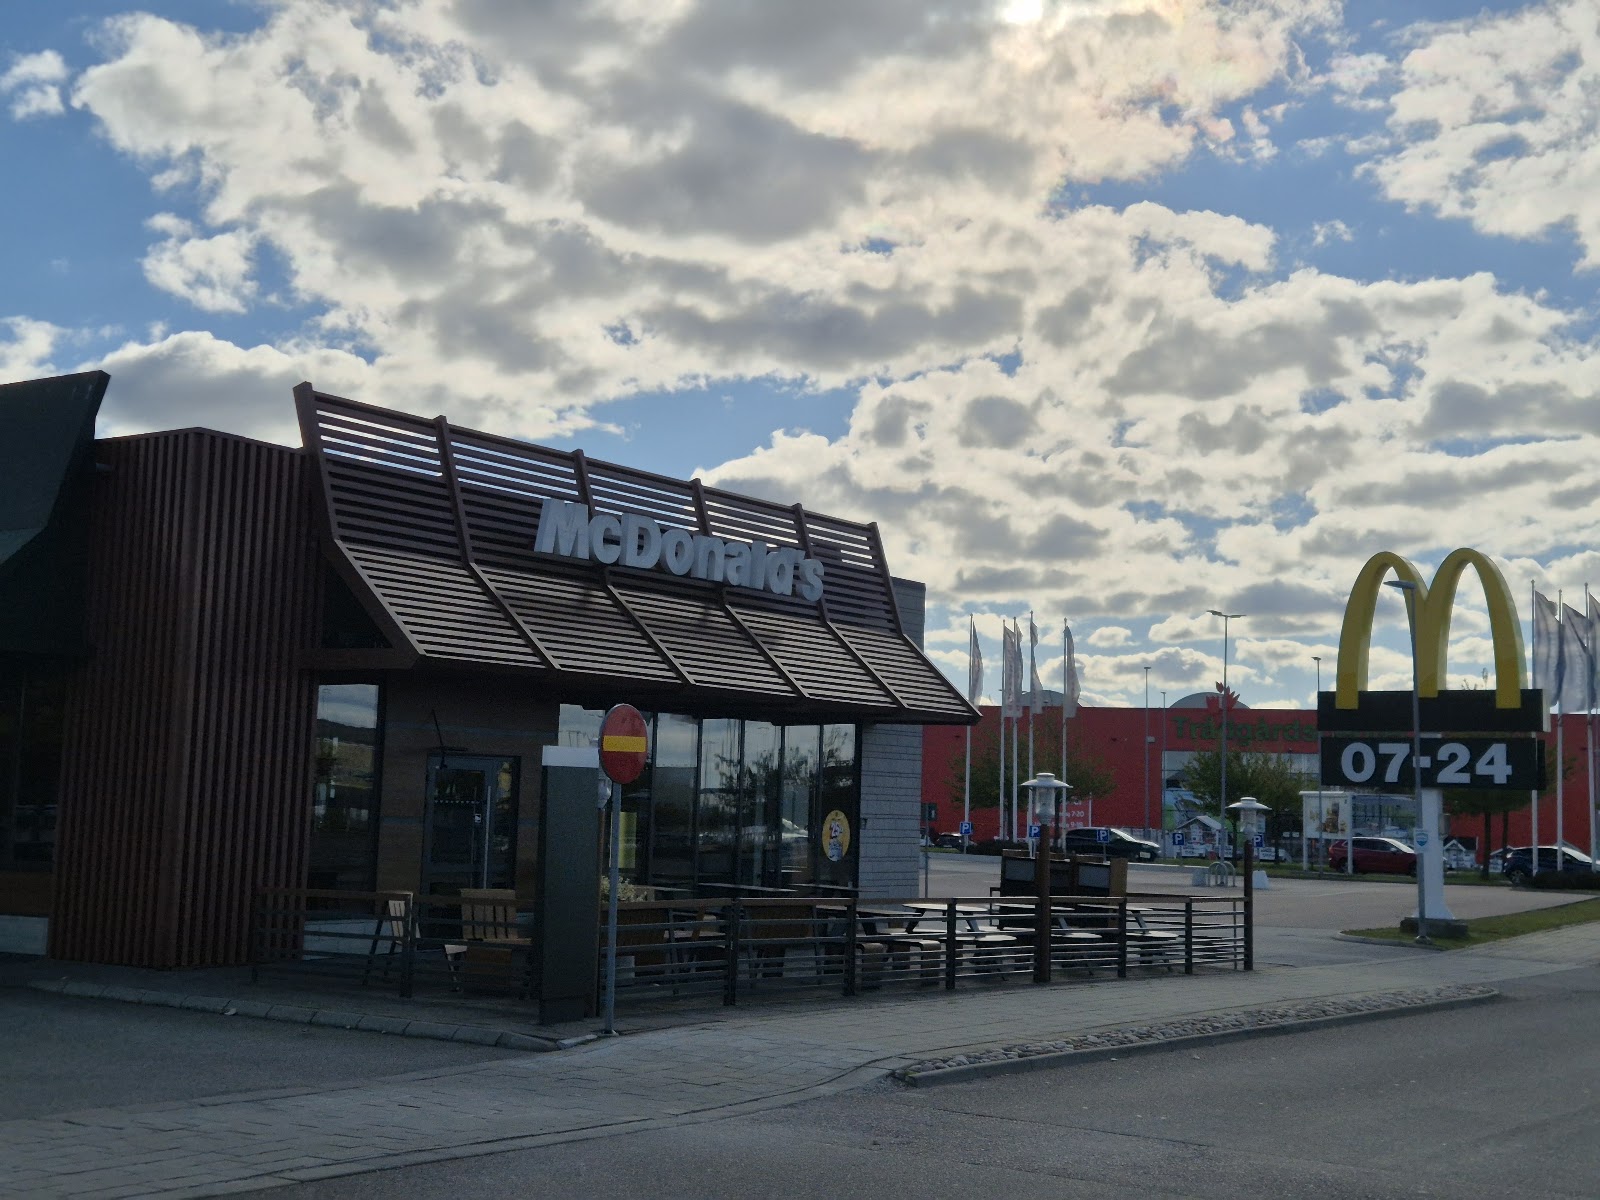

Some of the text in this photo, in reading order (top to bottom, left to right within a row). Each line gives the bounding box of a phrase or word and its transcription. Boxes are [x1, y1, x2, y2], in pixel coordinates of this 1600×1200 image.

[533, 498, 825, 602] McDonald's
[1341, 742, 1512, 784] 07-24
[962, 823, 970, 833] P
[1031, 827, 1039, 836] P
[1099, 830, 1107, 841] P
[1175, 833, 1182, 844] P
[1253, 835, 1261, 847] P
